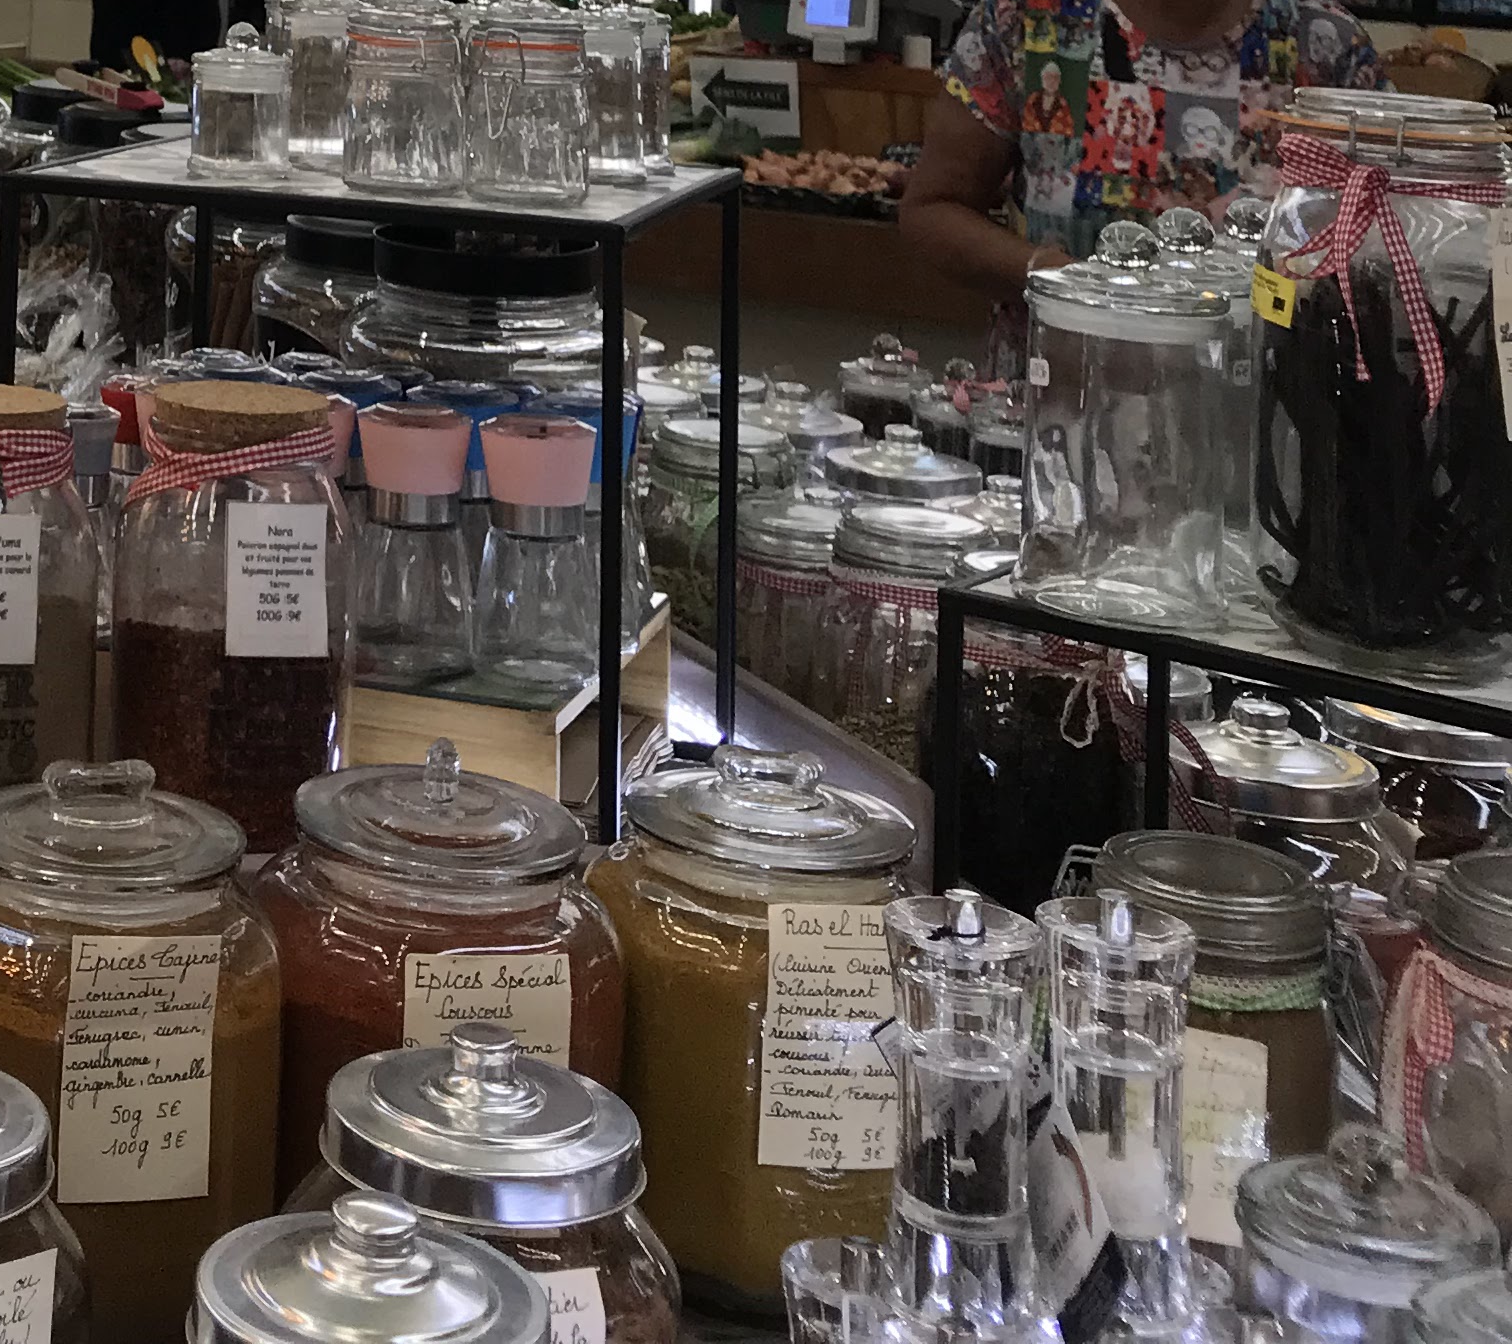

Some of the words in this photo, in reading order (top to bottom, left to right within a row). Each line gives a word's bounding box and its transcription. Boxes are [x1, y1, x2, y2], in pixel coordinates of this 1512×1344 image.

[268, 525, 294, 538] Nora
[781, 908, 824, 936] Ras
[828, 909, 852, 937] el
[76, 942, 147, 987] Epices
[150, 943, 221, 984] Tajine
[415, 959, 483, 1004] Epices
[490, 958, 567, 1004] Spécial
[776, 977, 880, 998] Délicatement
[435, 994, 515, 1020] Couscous
[773, 999, 843, 1026] pimenté
[110, 1105, 144, 1140] 50g
[156, 1099, 182, 1118] 5€
[765, 1100, 844, 1121] Romarin
[101, 1138, 150, 1170] 100g
[160, 1130, 188, 1150] 9€
[807, 1127, 840, 1150] 50g
[861, 1126, 885, 1144] 5€
[804, 1146, 847, 1169] 100g
[861, 1145, 886, 1162] 9€
[13, 1274, 41, 1293] ou
